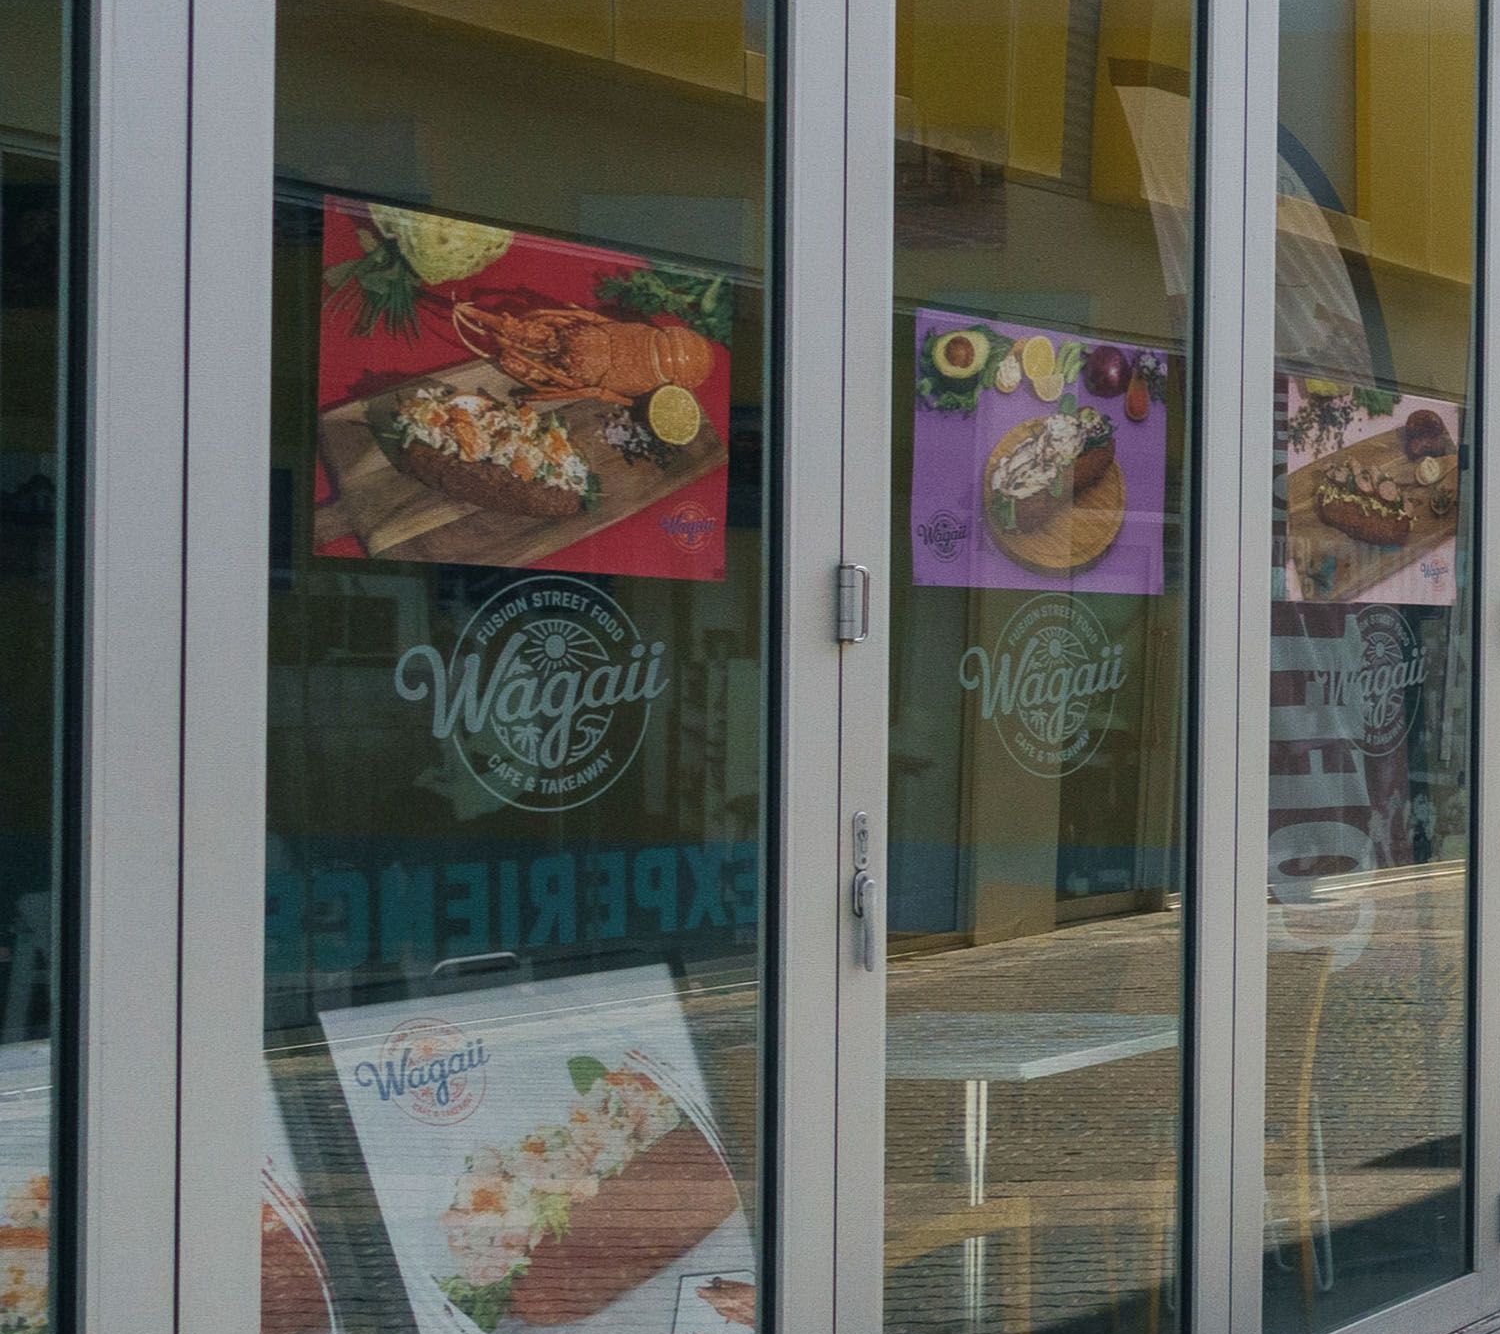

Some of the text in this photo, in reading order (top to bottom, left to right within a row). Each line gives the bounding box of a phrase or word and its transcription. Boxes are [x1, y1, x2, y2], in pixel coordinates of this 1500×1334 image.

[475, 591, 625, 645] FUSION STREET FOOD
[393, 632, 670, 768] Wagaii
[959, 637, 1128, 745] Wagaii
[486, 748, 614, 793] CAFE & TAKEAWAY
[354, 1037, 491, 1106] Wagaii
